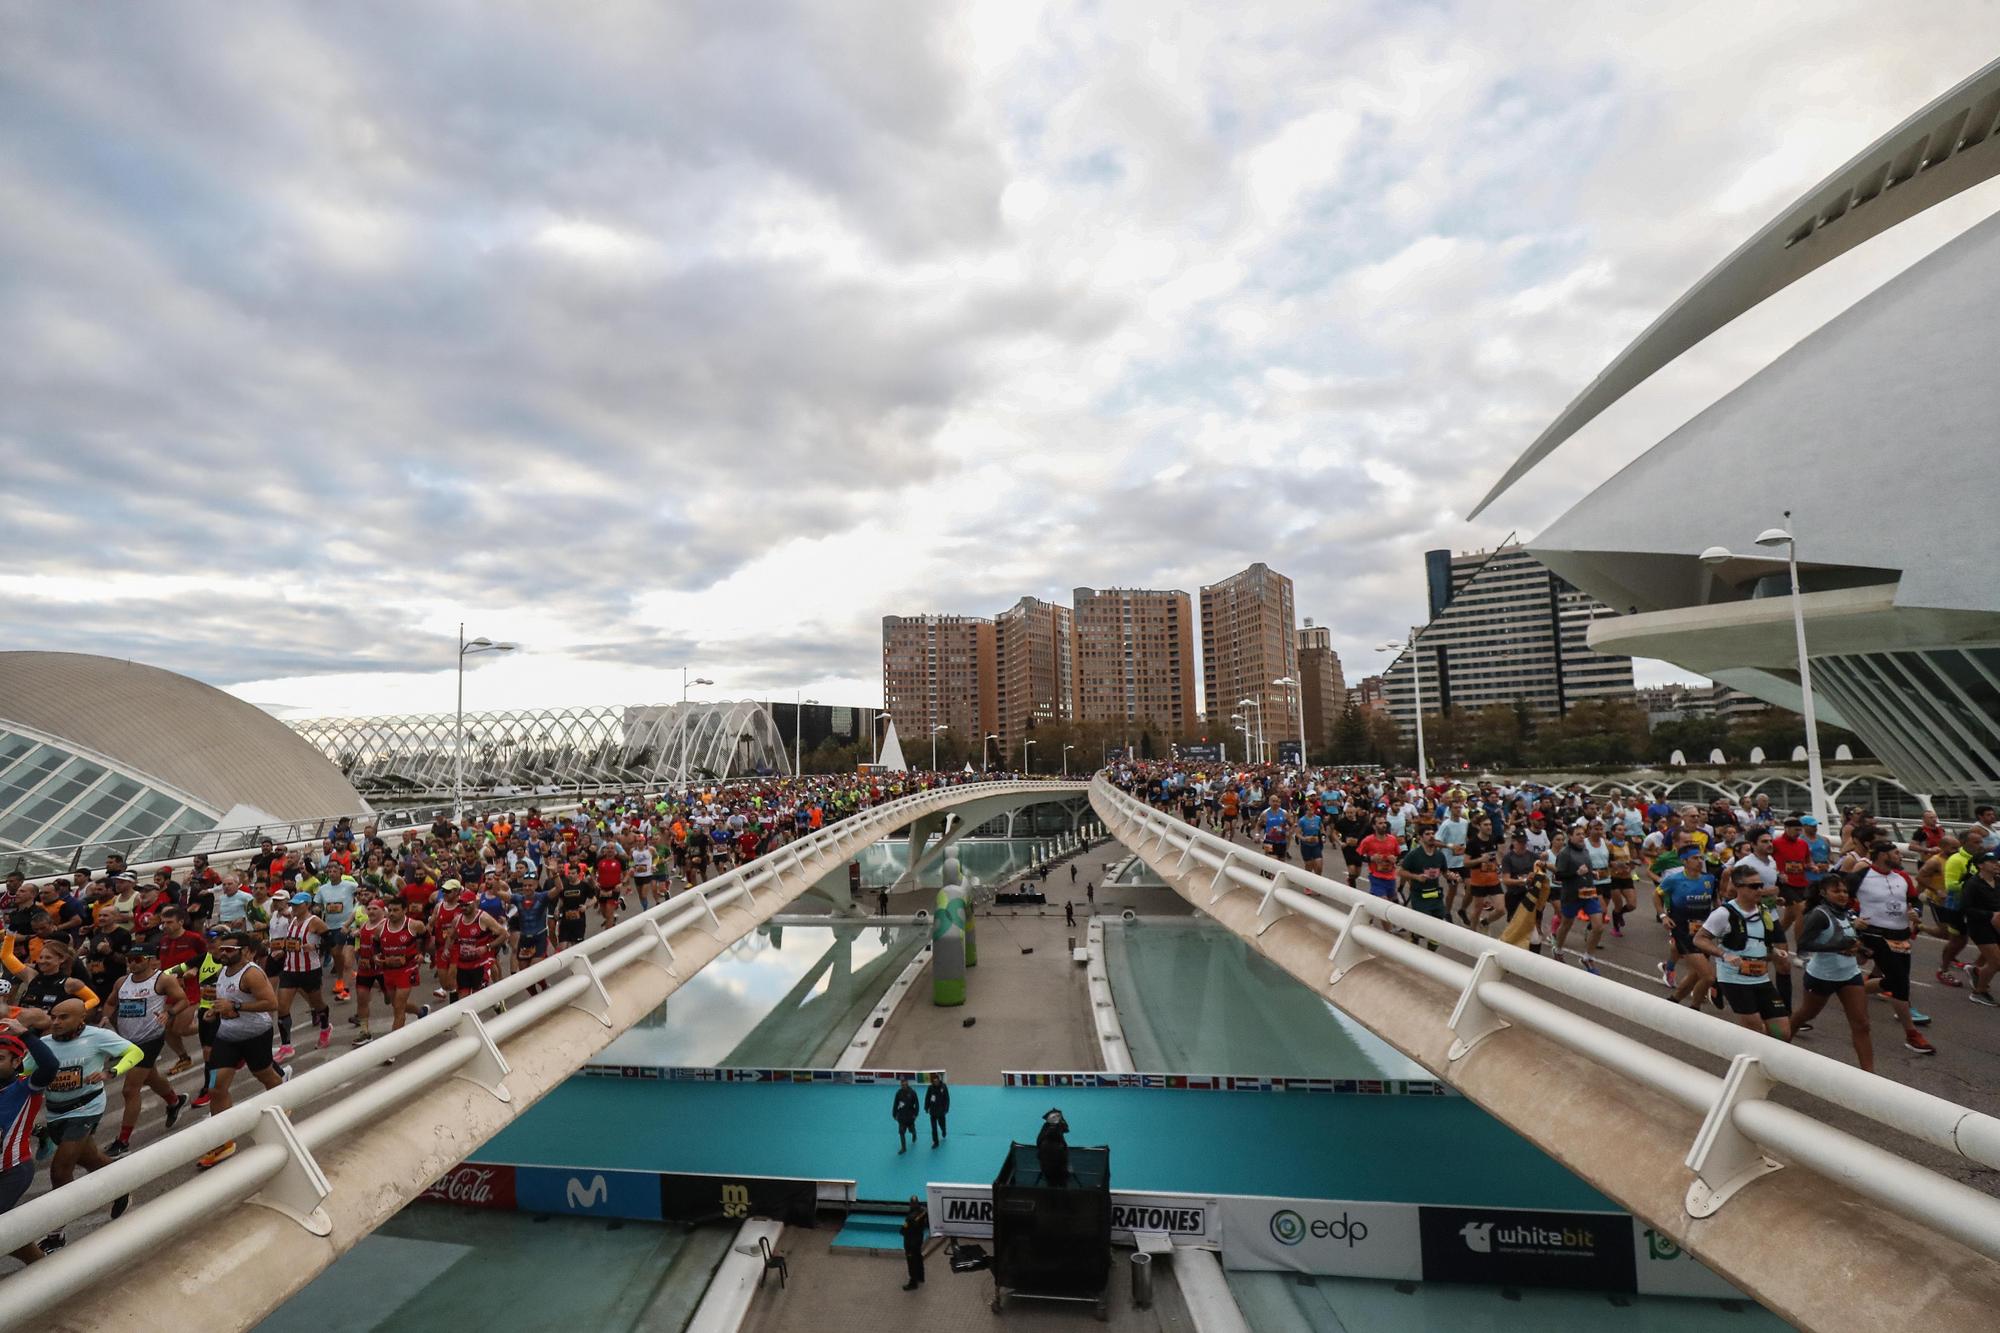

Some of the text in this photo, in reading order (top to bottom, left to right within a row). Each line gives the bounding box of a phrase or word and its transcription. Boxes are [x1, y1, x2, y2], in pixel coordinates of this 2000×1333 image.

[949, 1200, 994, 1221] MAR
[1310, 1211, 1368, 1248] edp
[1496, 1224, 1595, 1248] whitebit
